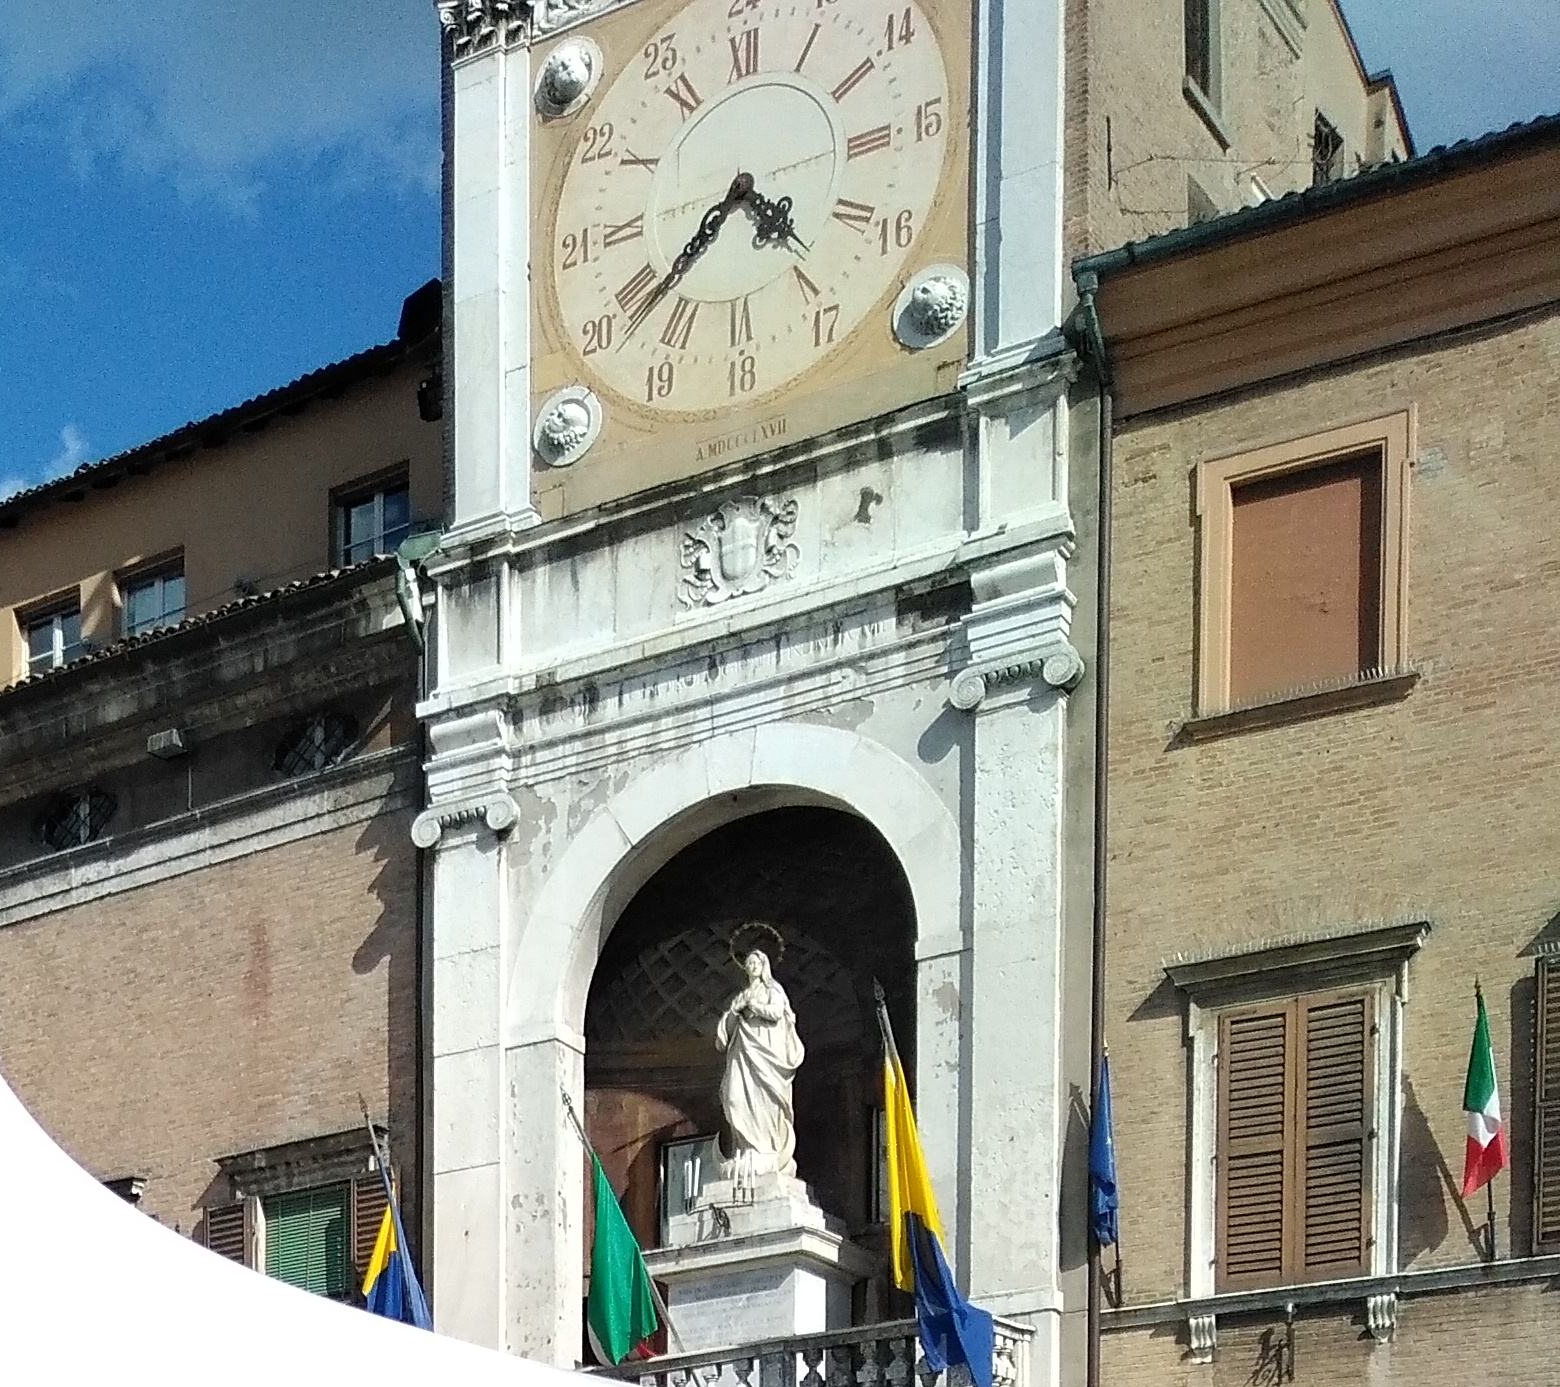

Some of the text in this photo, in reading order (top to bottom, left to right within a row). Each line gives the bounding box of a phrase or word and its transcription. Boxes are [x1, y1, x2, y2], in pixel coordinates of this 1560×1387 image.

[884, 7, 915, 51] 14
[644, 32, 677, 80] 23
[727, 27, 760, 84] XII
[664, 72, 704, 123] XI
[915, 97, 943, 143] 15
[581, 122, 614, 165] 22
[619, 148, 660, 174] X
[562, 227, 589, 271] 21
[878, 209, 913, 256] 16
[793, 265, 820, 305] V
[582, 314, 612, 357] 20
[730, 295, 754, 348] VI
[812, 303, 840, 348] 17
[646, 361, 674, 402] 19
[727, 356, 756, 397] 18
